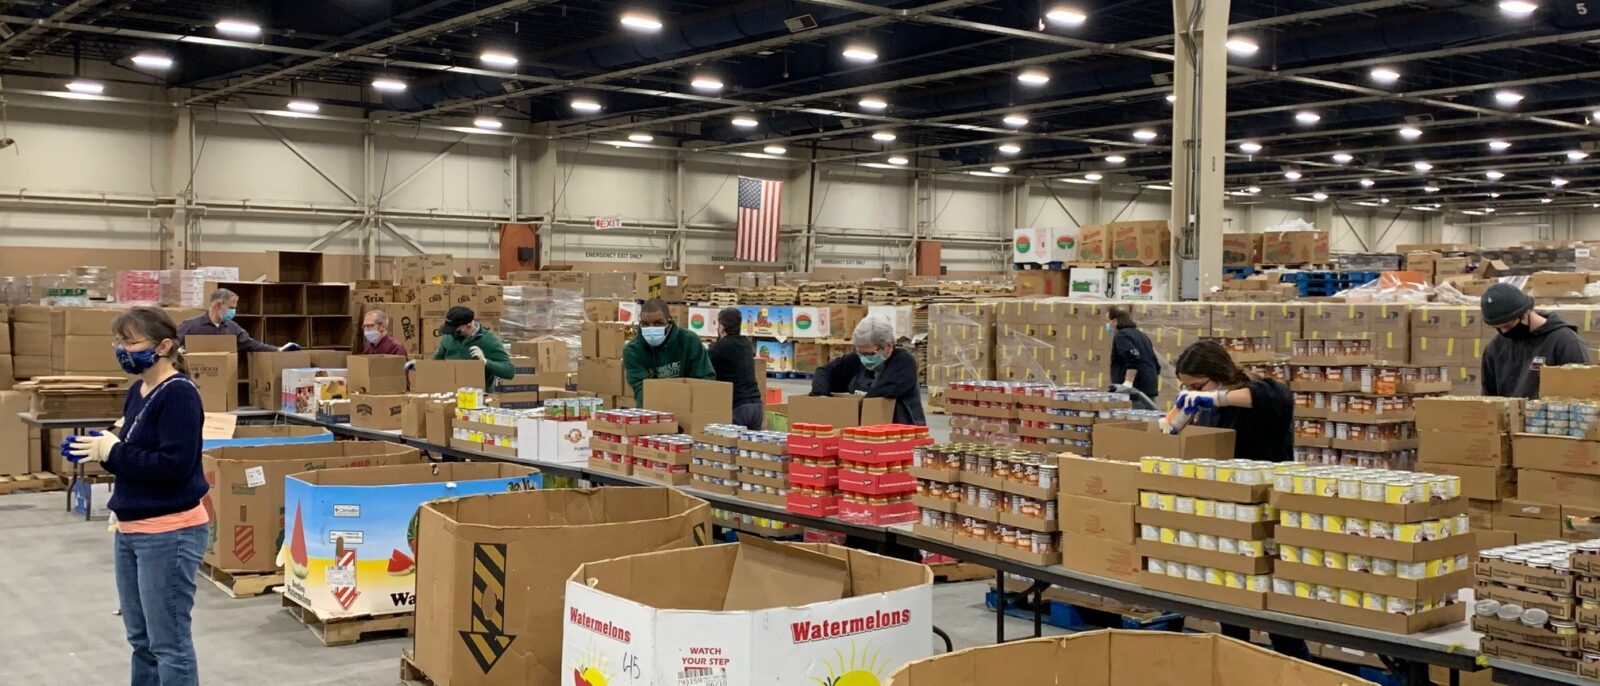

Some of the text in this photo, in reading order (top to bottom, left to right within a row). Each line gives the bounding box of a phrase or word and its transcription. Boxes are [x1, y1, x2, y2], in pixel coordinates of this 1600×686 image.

[1576, 3, 1587, 15] 5
[600, 219, 621, 228] EXIT
[585, 251, 617, 259] EMERGENCY
[617, 252, 629, 260] EXIT
[364, 293, 384, 303] Trix
[570, 606, 632, 644] Watermelons
[791, 608, 912, 644] Watermelons
[690, 647, 722, 655] WATCH
[682, 657, 707, 665] YOUR
